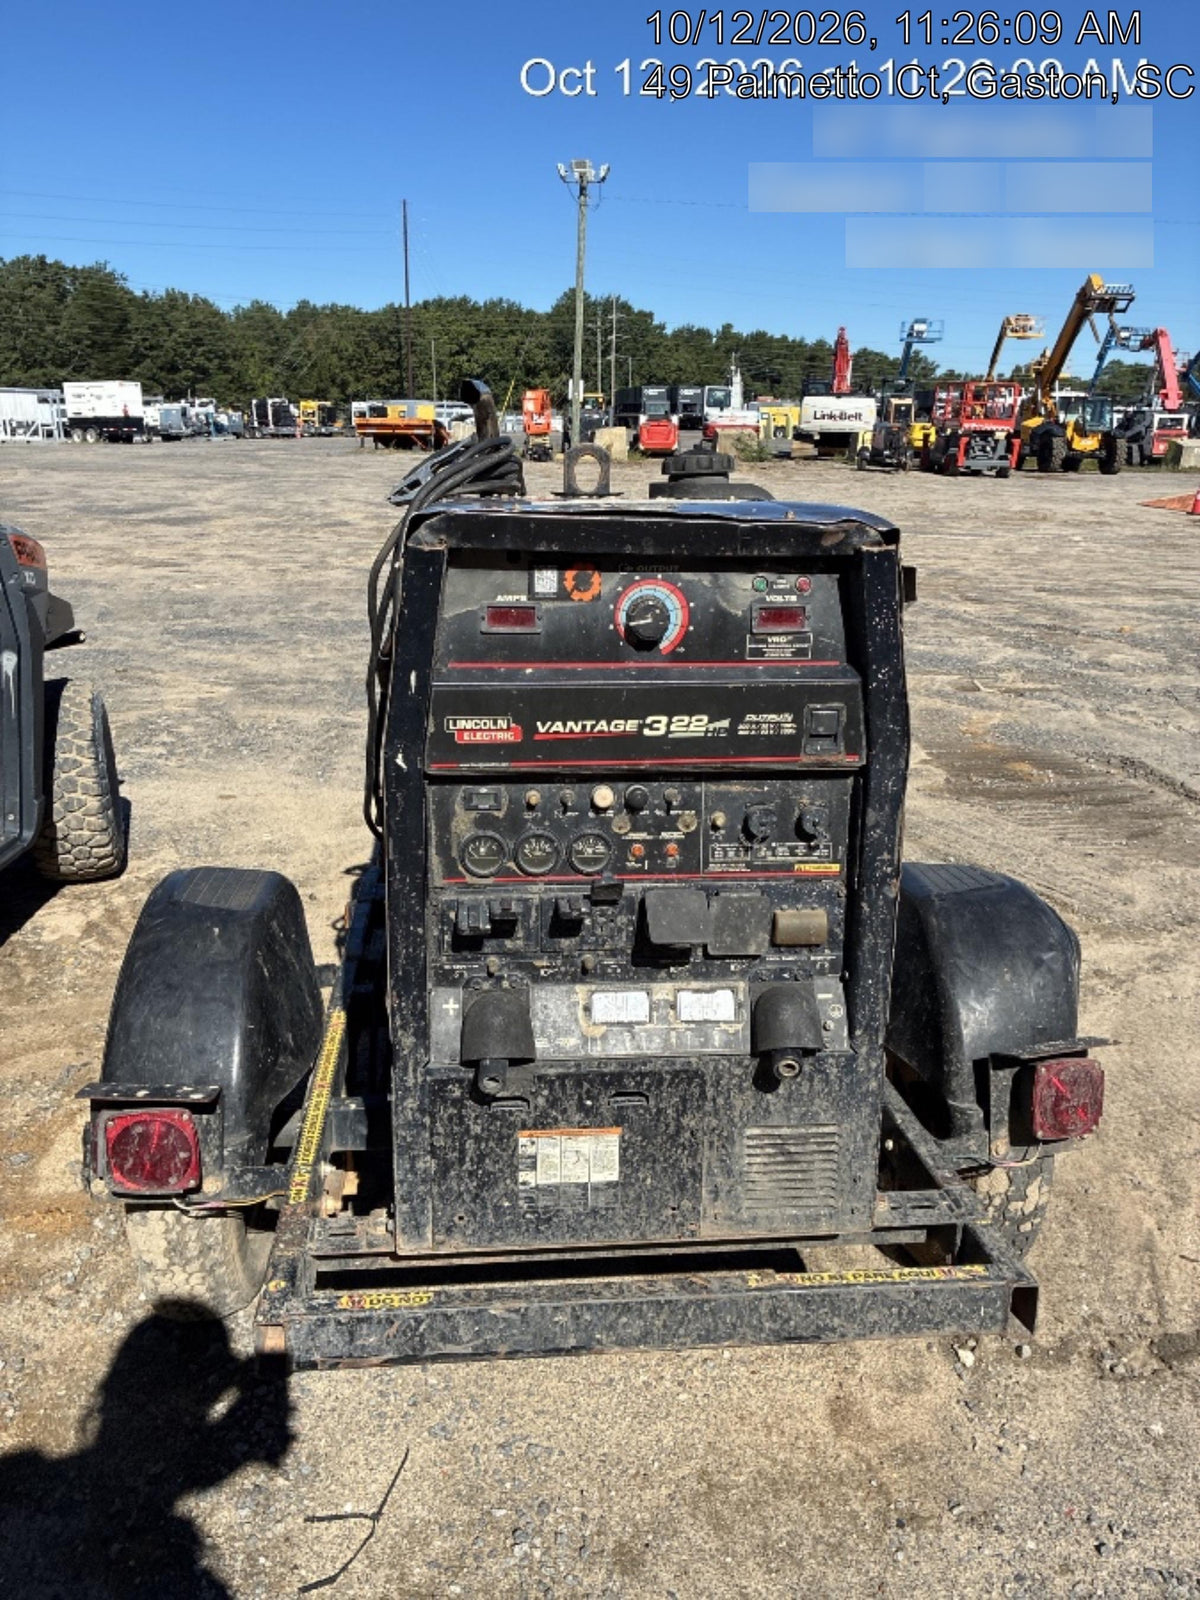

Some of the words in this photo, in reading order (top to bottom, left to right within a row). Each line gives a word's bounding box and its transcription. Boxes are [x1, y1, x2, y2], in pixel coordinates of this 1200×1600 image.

[813, 410, 863, 422] Link-Belt
[449, 718, 508, 731] LINCOLN
[536, 719, 641, 734] VANTAGE
[642, 714, 710, 737] 322
[462, 731, 516, 742] ELECTRIC
